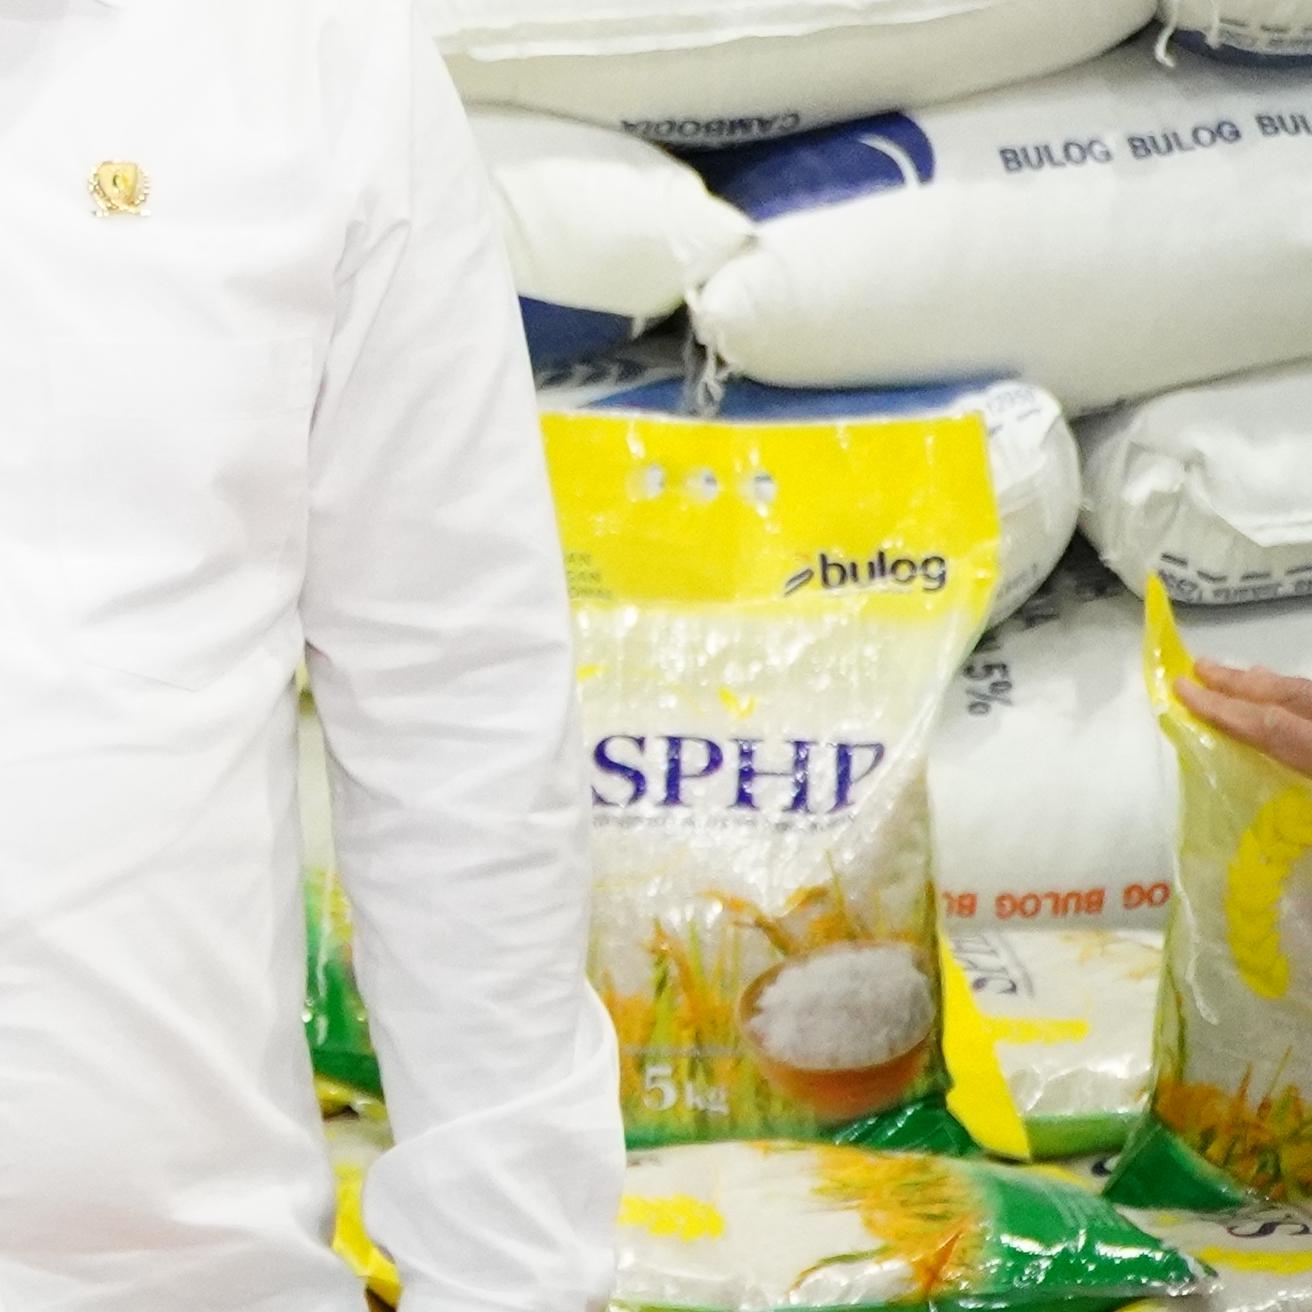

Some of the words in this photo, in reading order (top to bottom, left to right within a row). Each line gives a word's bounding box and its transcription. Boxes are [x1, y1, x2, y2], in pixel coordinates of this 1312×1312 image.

[999, 139, 1114, 174] BULOG
[1127, 119, 1242, 160] BULOG
[1255, 110, 1312, 138] BUL
[819, 549, 948, 594] bulog
[590, 734, 886, 816] SPHP
[995, 888, 1106, 919] BULOG
[642, 1064, 677, 1113] 5
